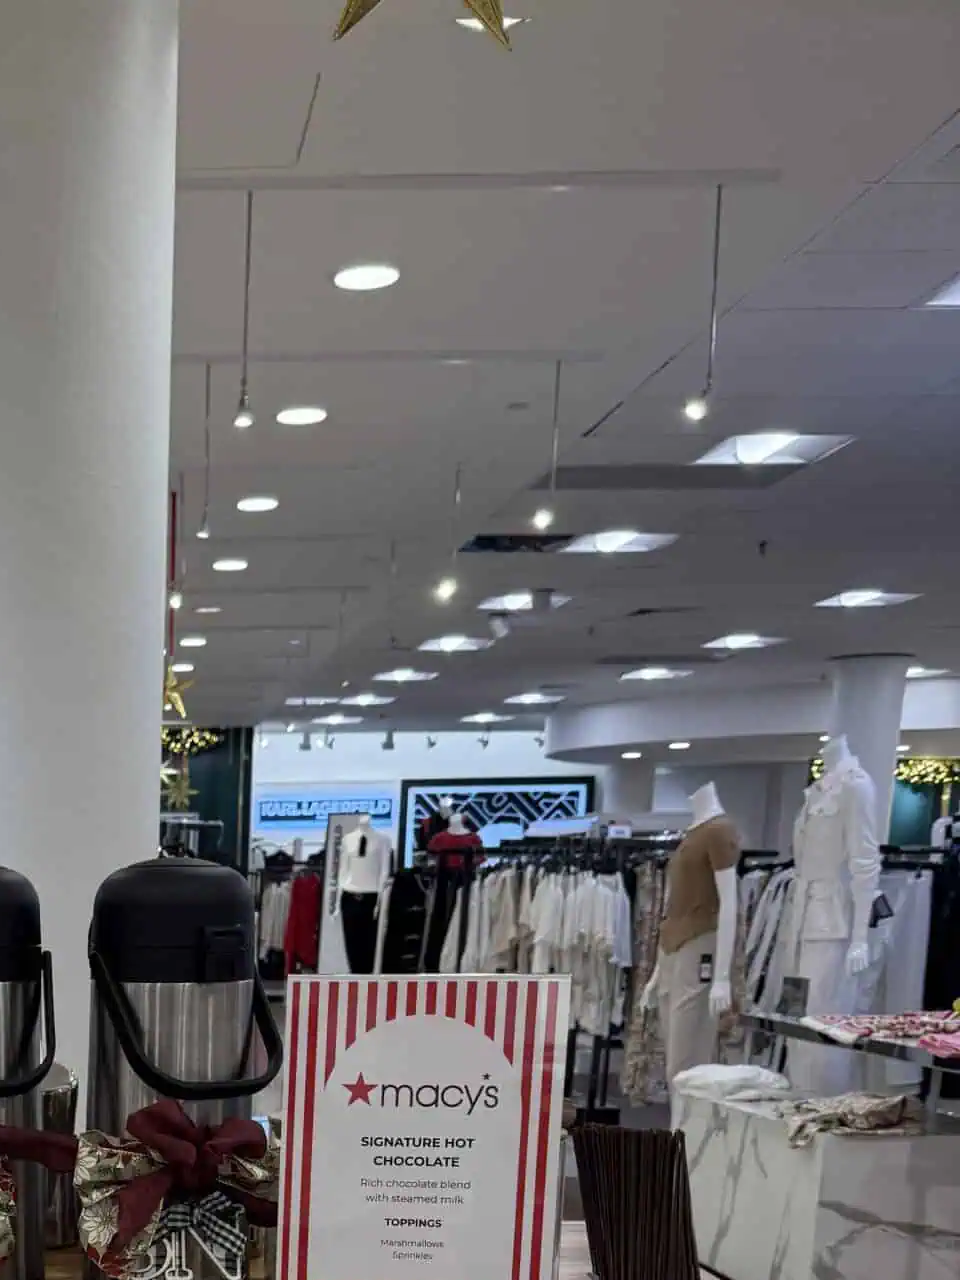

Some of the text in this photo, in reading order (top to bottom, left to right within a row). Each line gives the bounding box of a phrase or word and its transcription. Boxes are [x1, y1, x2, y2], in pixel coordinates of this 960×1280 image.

[360, 1136, 476, 1149] SIGNATURE HOT
[373, 1156, 460, 1168] CHOCOLATE
[360, 1178, 472, 1190] Rich chocolate blend
[365, 1193, 464, 1205] with steamed milk
[384, 1217, 442, 1228] TOPPINGS
[380, 1239, 444, 1249] Marshmallows
